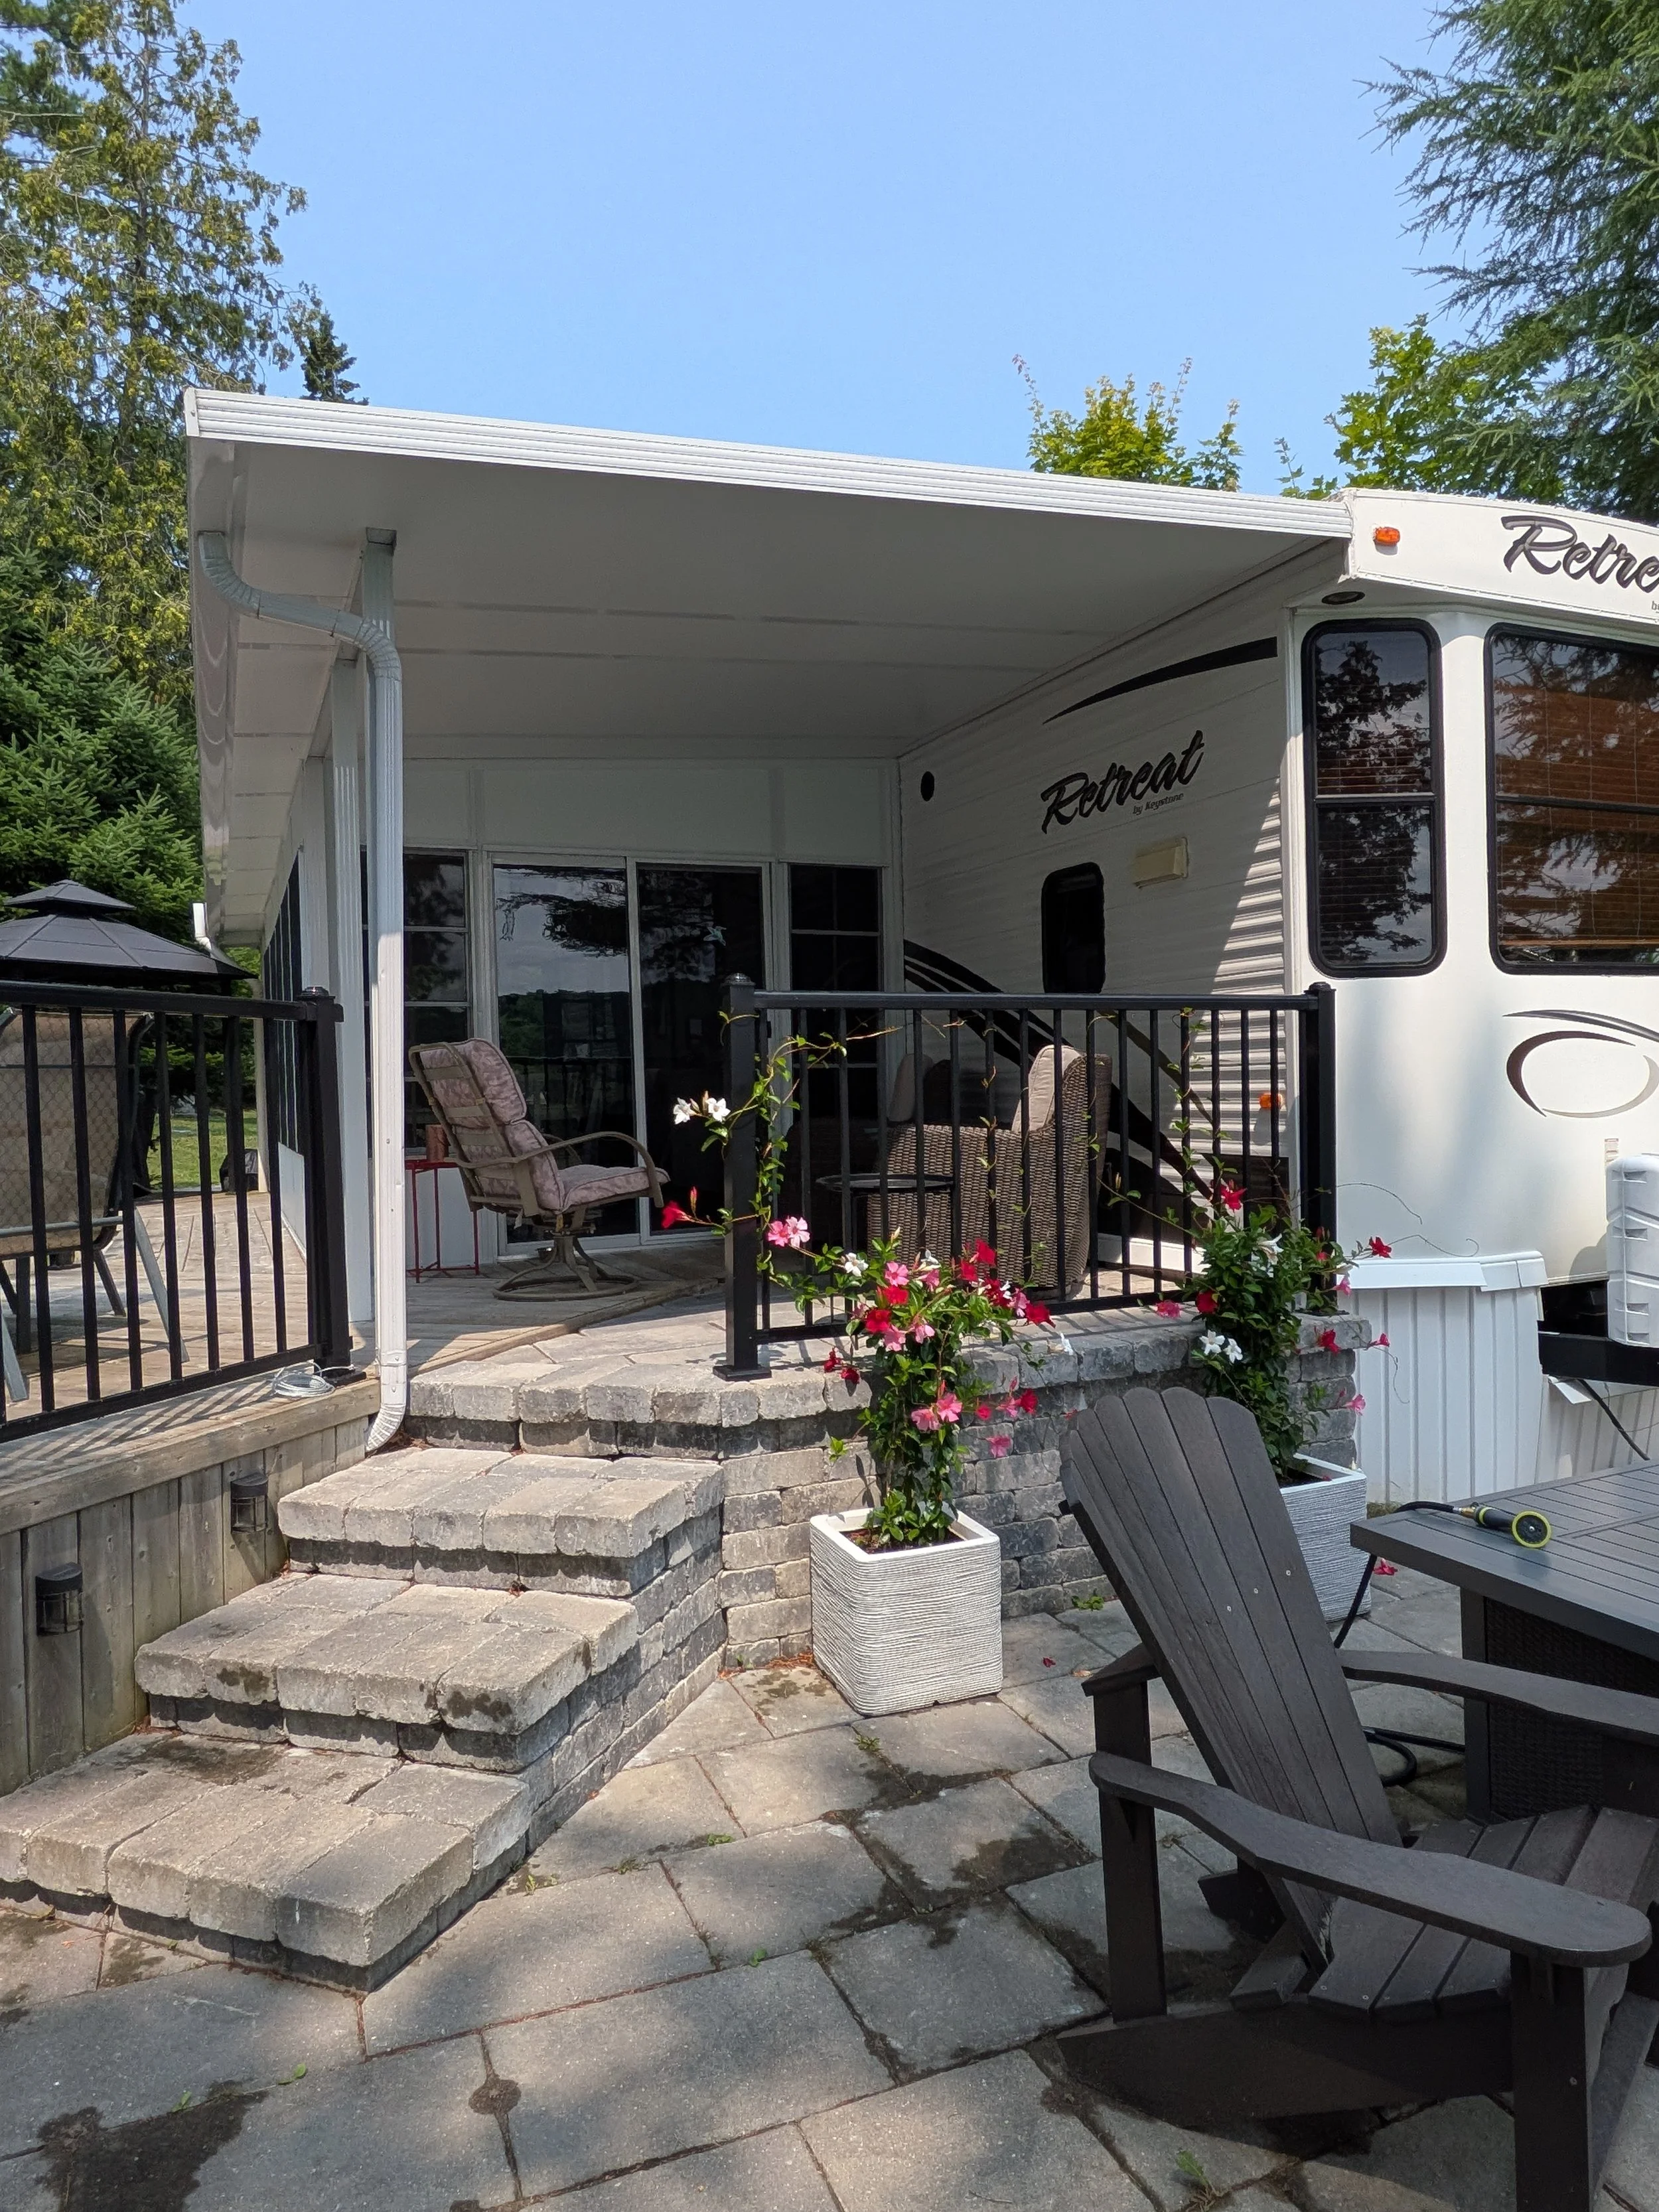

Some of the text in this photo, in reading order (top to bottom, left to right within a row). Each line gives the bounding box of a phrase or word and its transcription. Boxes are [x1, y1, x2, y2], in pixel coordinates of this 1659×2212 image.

[1041, 730, 1204, 834] Retreat
[1132, 792, 1185, 816] by Keystone
